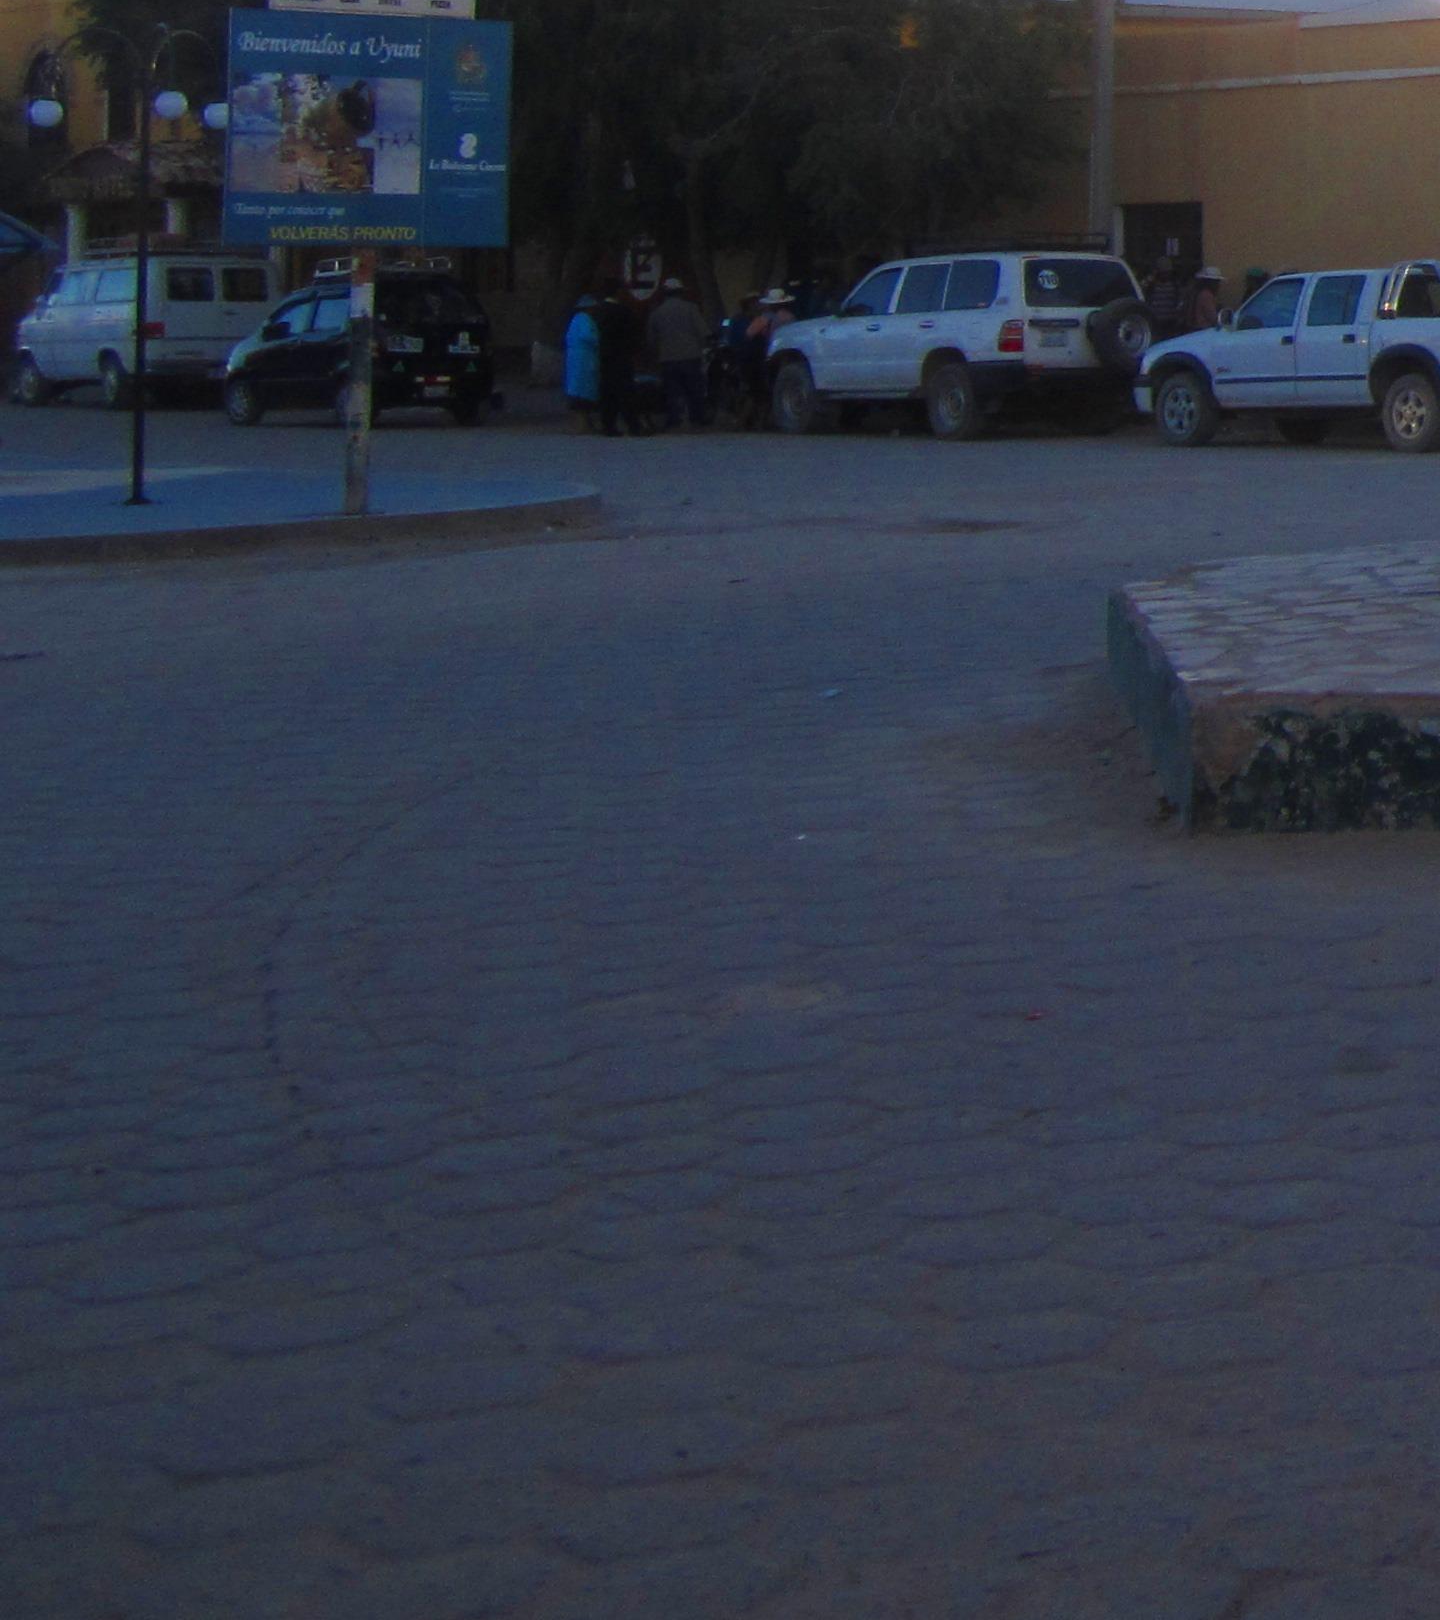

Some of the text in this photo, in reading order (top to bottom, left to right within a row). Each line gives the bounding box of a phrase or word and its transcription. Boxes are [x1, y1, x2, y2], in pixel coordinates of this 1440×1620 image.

[238, 31, 422, 63] Bienvenidos a Uyuni
[266, 206, 286, 220] por
[269, 225, 417, 241] VOLVERÁS PRONTO
